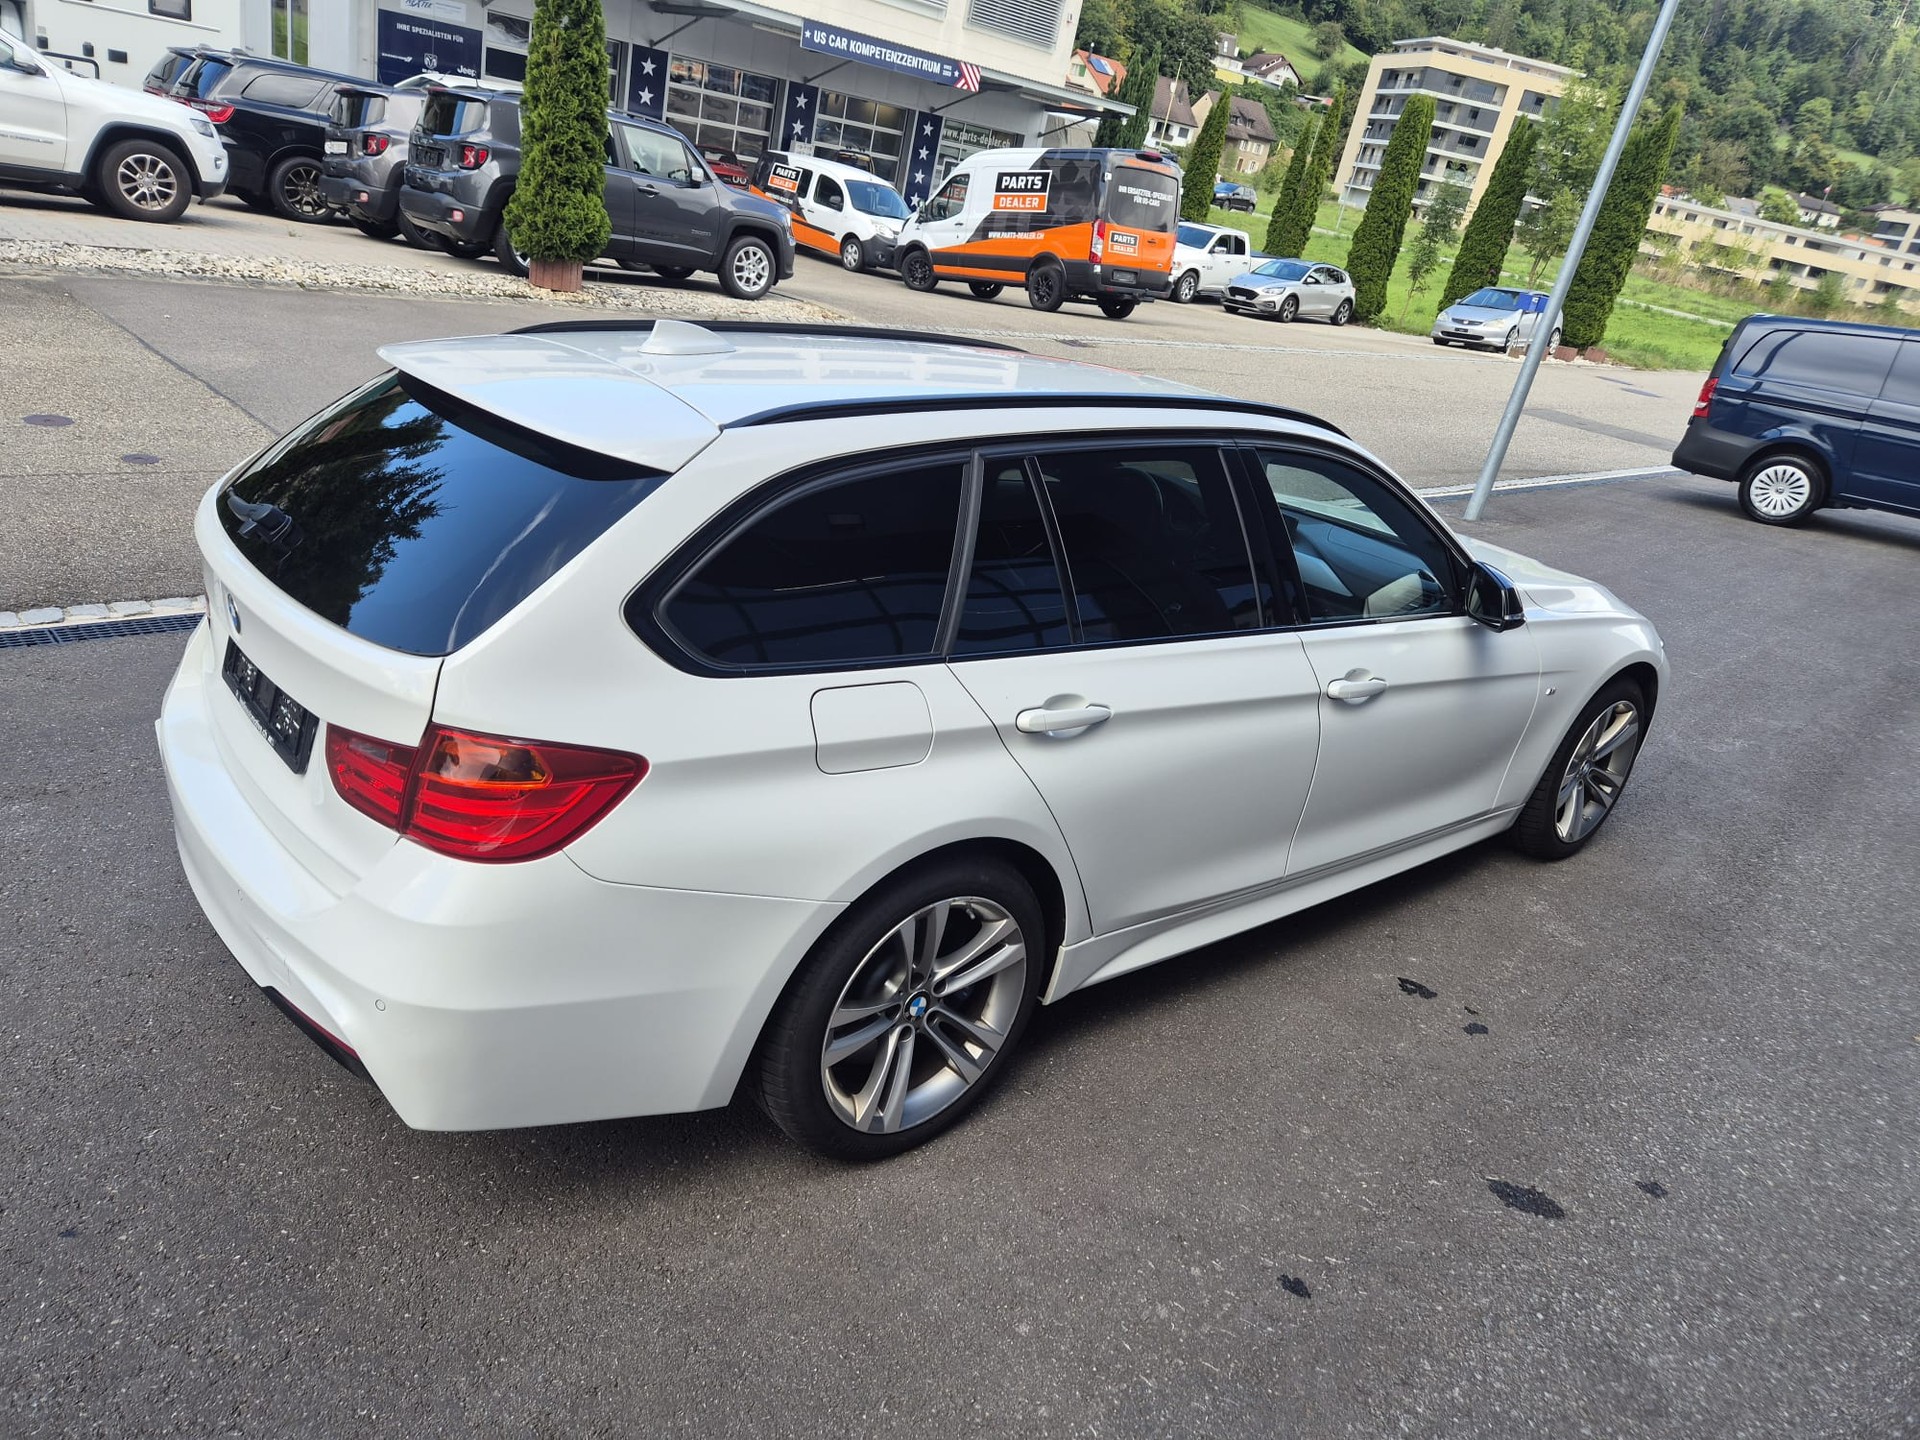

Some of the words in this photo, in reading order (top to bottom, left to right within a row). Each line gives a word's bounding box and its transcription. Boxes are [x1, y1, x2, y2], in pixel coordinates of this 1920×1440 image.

[396, 22, 411, 33] IHRE
[411, 26, 452, 40] SPEZIALISTEN
[452, 33, 464, 44] FÜR
[813, 30, 827, 45] US
[828, 34, 848, 51] CAR
[849, 39, 941, 75] KOMPETENZZENTRUM
[456, 65, 477, 77] Jeep
[775, 167, 797, 179] PARTS
[1001, 175, 1043, 190] PARTS
[999, 196, 1039, 208] DEALER
[1113, 234, 1135, 245] PARTS
